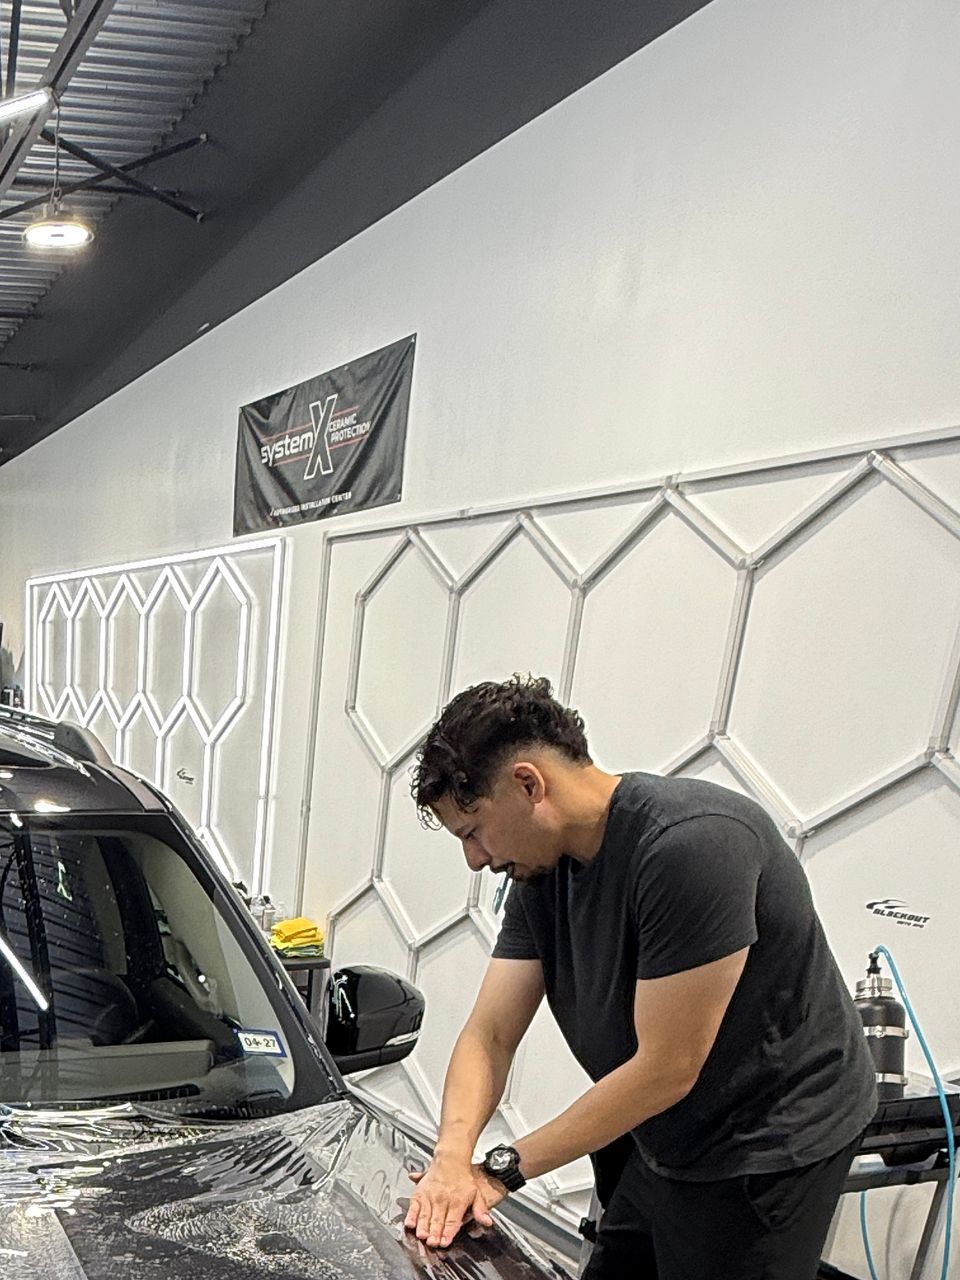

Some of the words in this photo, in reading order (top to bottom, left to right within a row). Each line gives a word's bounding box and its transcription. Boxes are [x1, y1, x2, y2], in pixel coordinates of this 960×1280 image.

[329, 412, 357, 432] CERAMIC
[330, 420, 371, 443] PROTECTION
[873, 908, 931, 923] BLACKOUT
